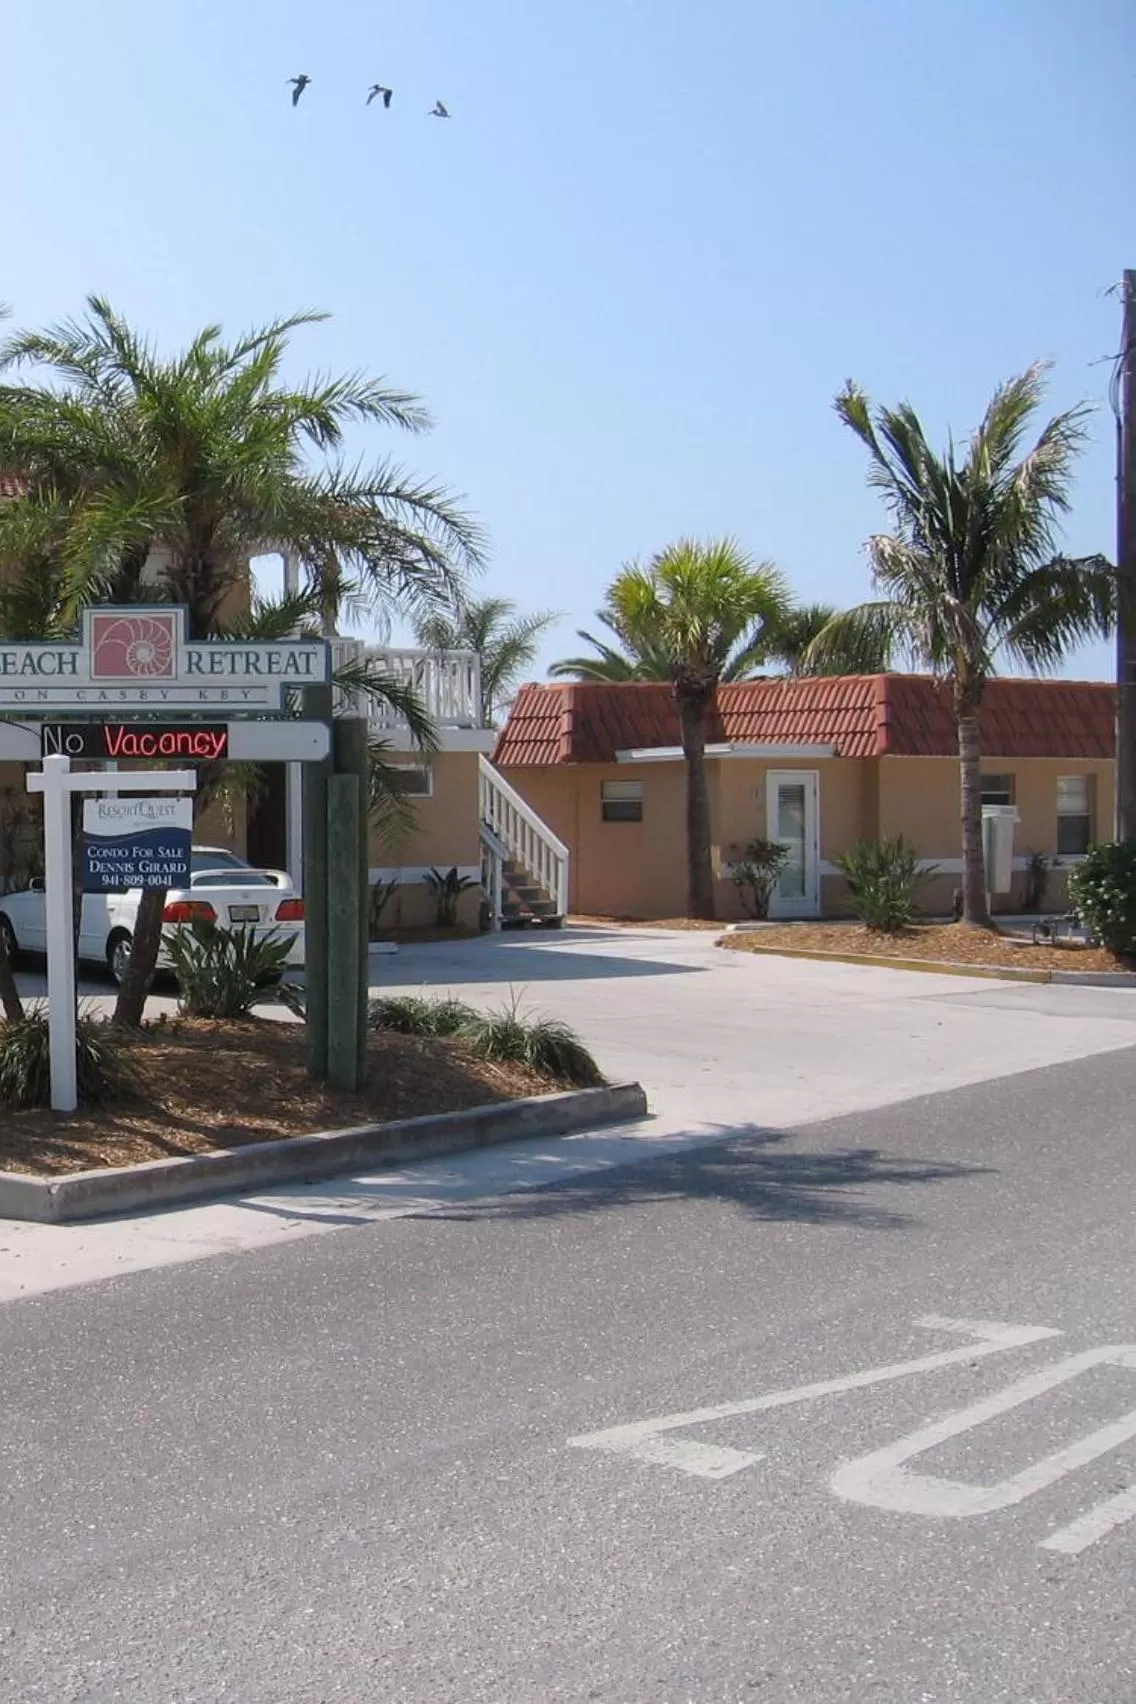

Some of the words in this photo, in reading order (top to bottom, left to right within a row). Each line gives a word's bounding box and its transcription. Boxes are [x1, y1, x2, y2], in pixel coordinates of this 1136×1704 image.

[185, 651, 317, 675] RETREAT
[14, 690, 48, 700] ON
[76, 690, 169, 701] CASEY
[198, 690, 252, 700] KEY
[43, 725, 85, 756] No
[103, 725, 227, 759] Vacancy
